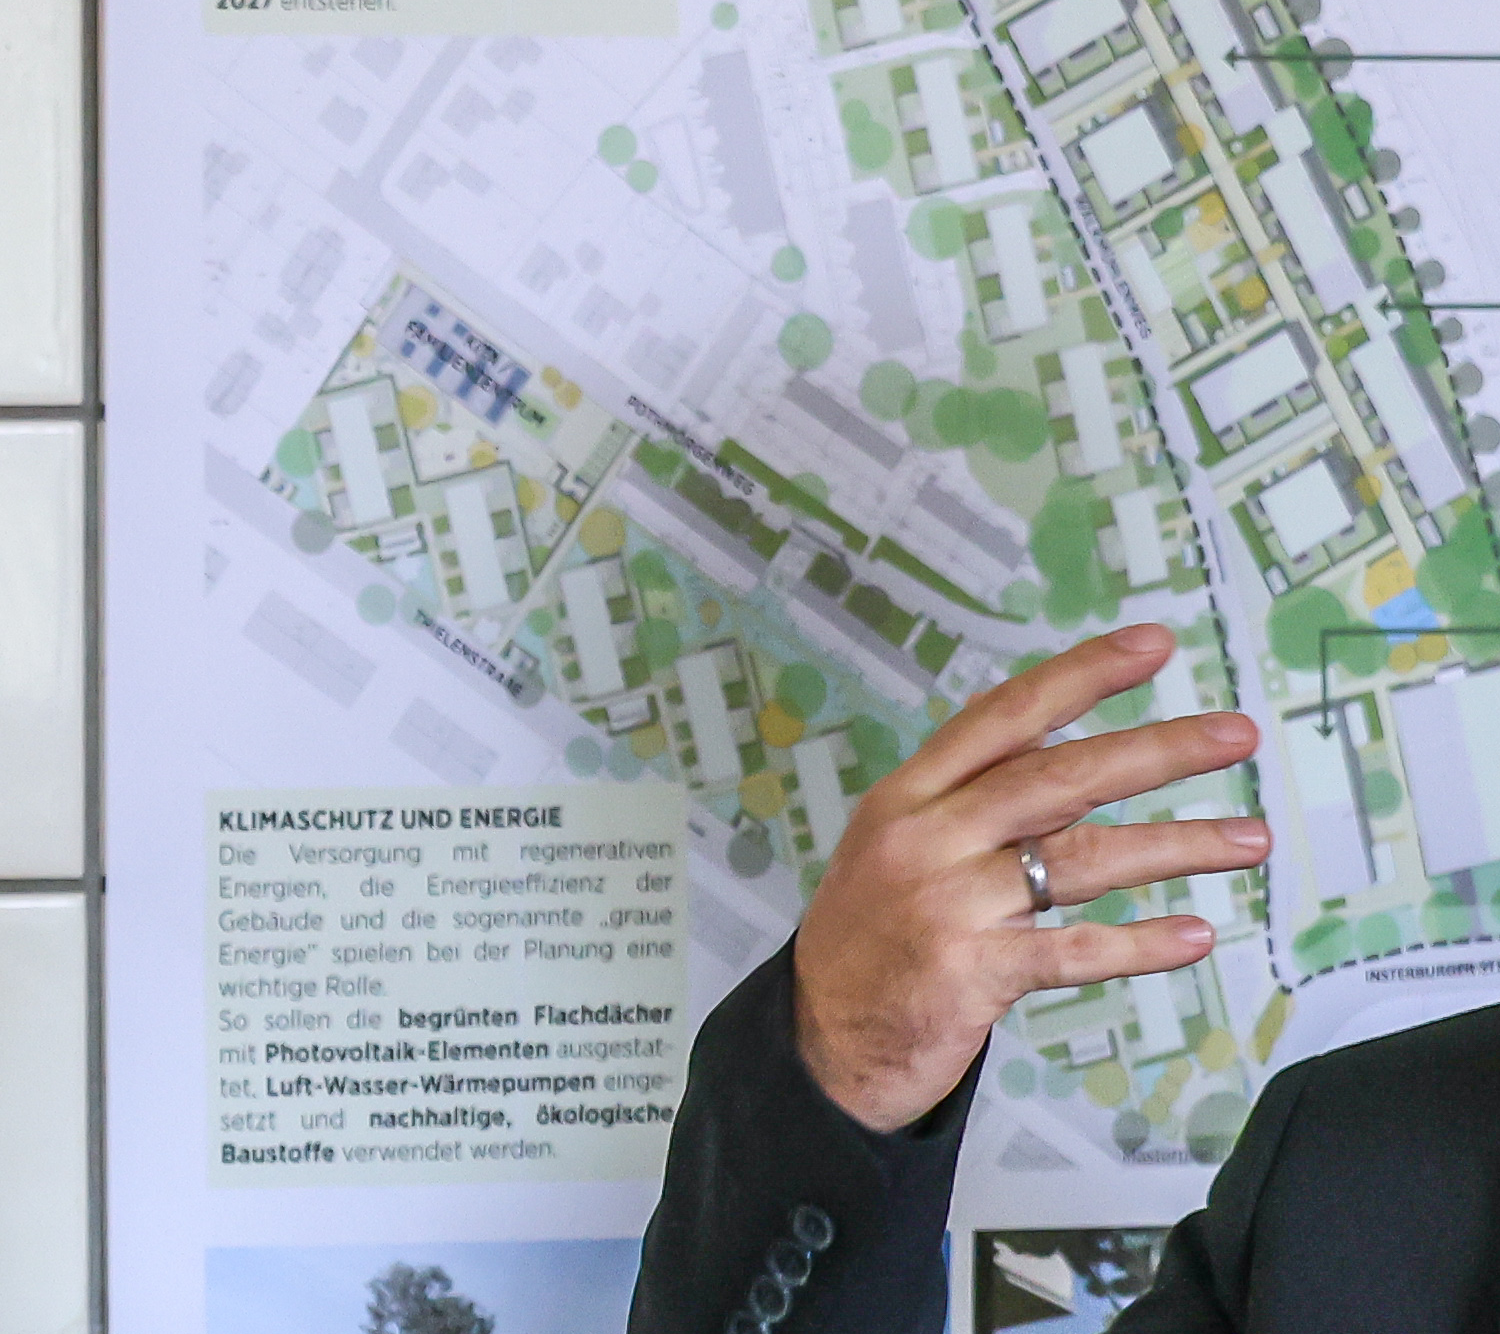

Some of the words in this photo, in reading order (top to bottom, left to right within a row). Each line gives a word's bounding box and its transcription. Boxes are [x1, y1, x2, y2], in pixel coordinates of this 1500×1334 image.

[219, 809, 394, 832] KLIMASCHUTZ
[400, 808, 453, 830] UND
[459, 806, 562, 829] ENERGIE
[264, 1039, 551, 1064] Photovoltaik-Elementen
